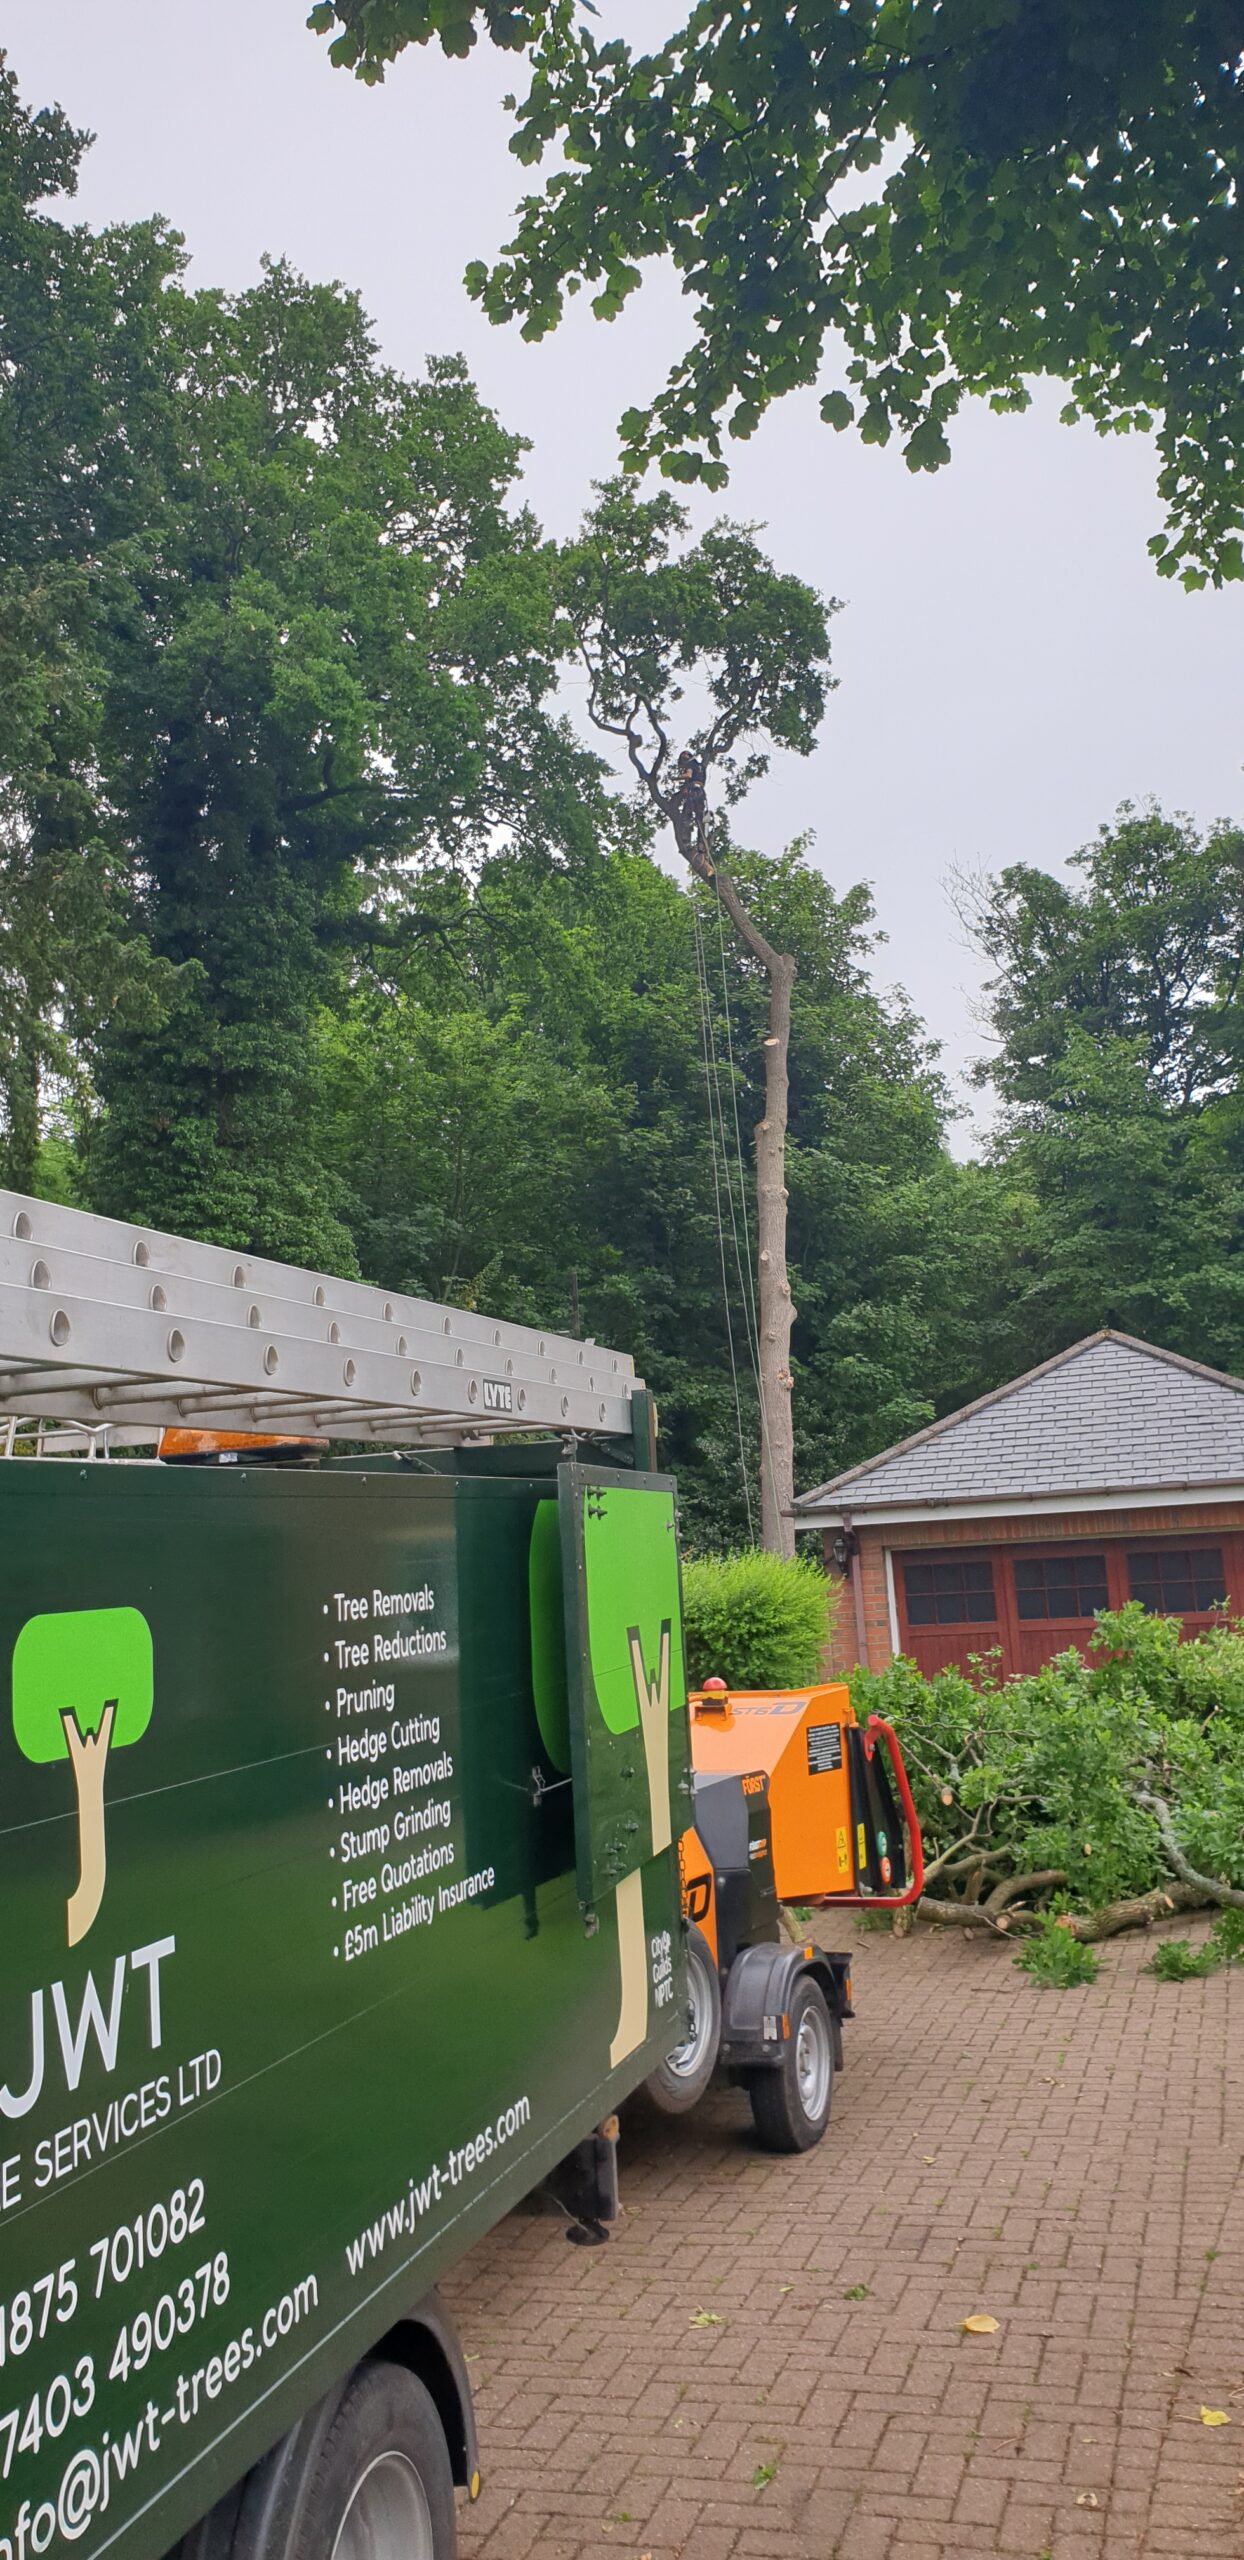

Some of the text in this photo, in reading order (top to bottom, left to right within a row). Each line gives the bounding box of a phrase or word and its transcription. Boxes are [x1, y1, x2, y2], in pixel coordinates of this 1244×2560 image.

[484, 1382, 511, 1409] LYTE
[333, 1583, 435, 1622] Tree Removals
[335, 1626, 447, 1669] Tree Reductions
[336, 1679, 395, 1718] Pruning
[338, 1713, 440, 1766] Hedge Cutting
[340, 1751, 453, 1814] Hedge Removals
[341, 1798, 451, 1863] Stump Grinding
[343, 1843, 454, 1912] Free Quotations
[345, 1867, 495, 1961] £5m Liability Insurance
[0, 1935, 175, 2118] JWT
[34, 2076, 171, 2187] SERVICES
[178, 2049, 221, 2106] LTD
[346, 2096, 531, 2275] www.jwt-trees.com
[90, 2178, 205, 2298] 701082
[0, 2252, 230, 2479] 7403 490378
